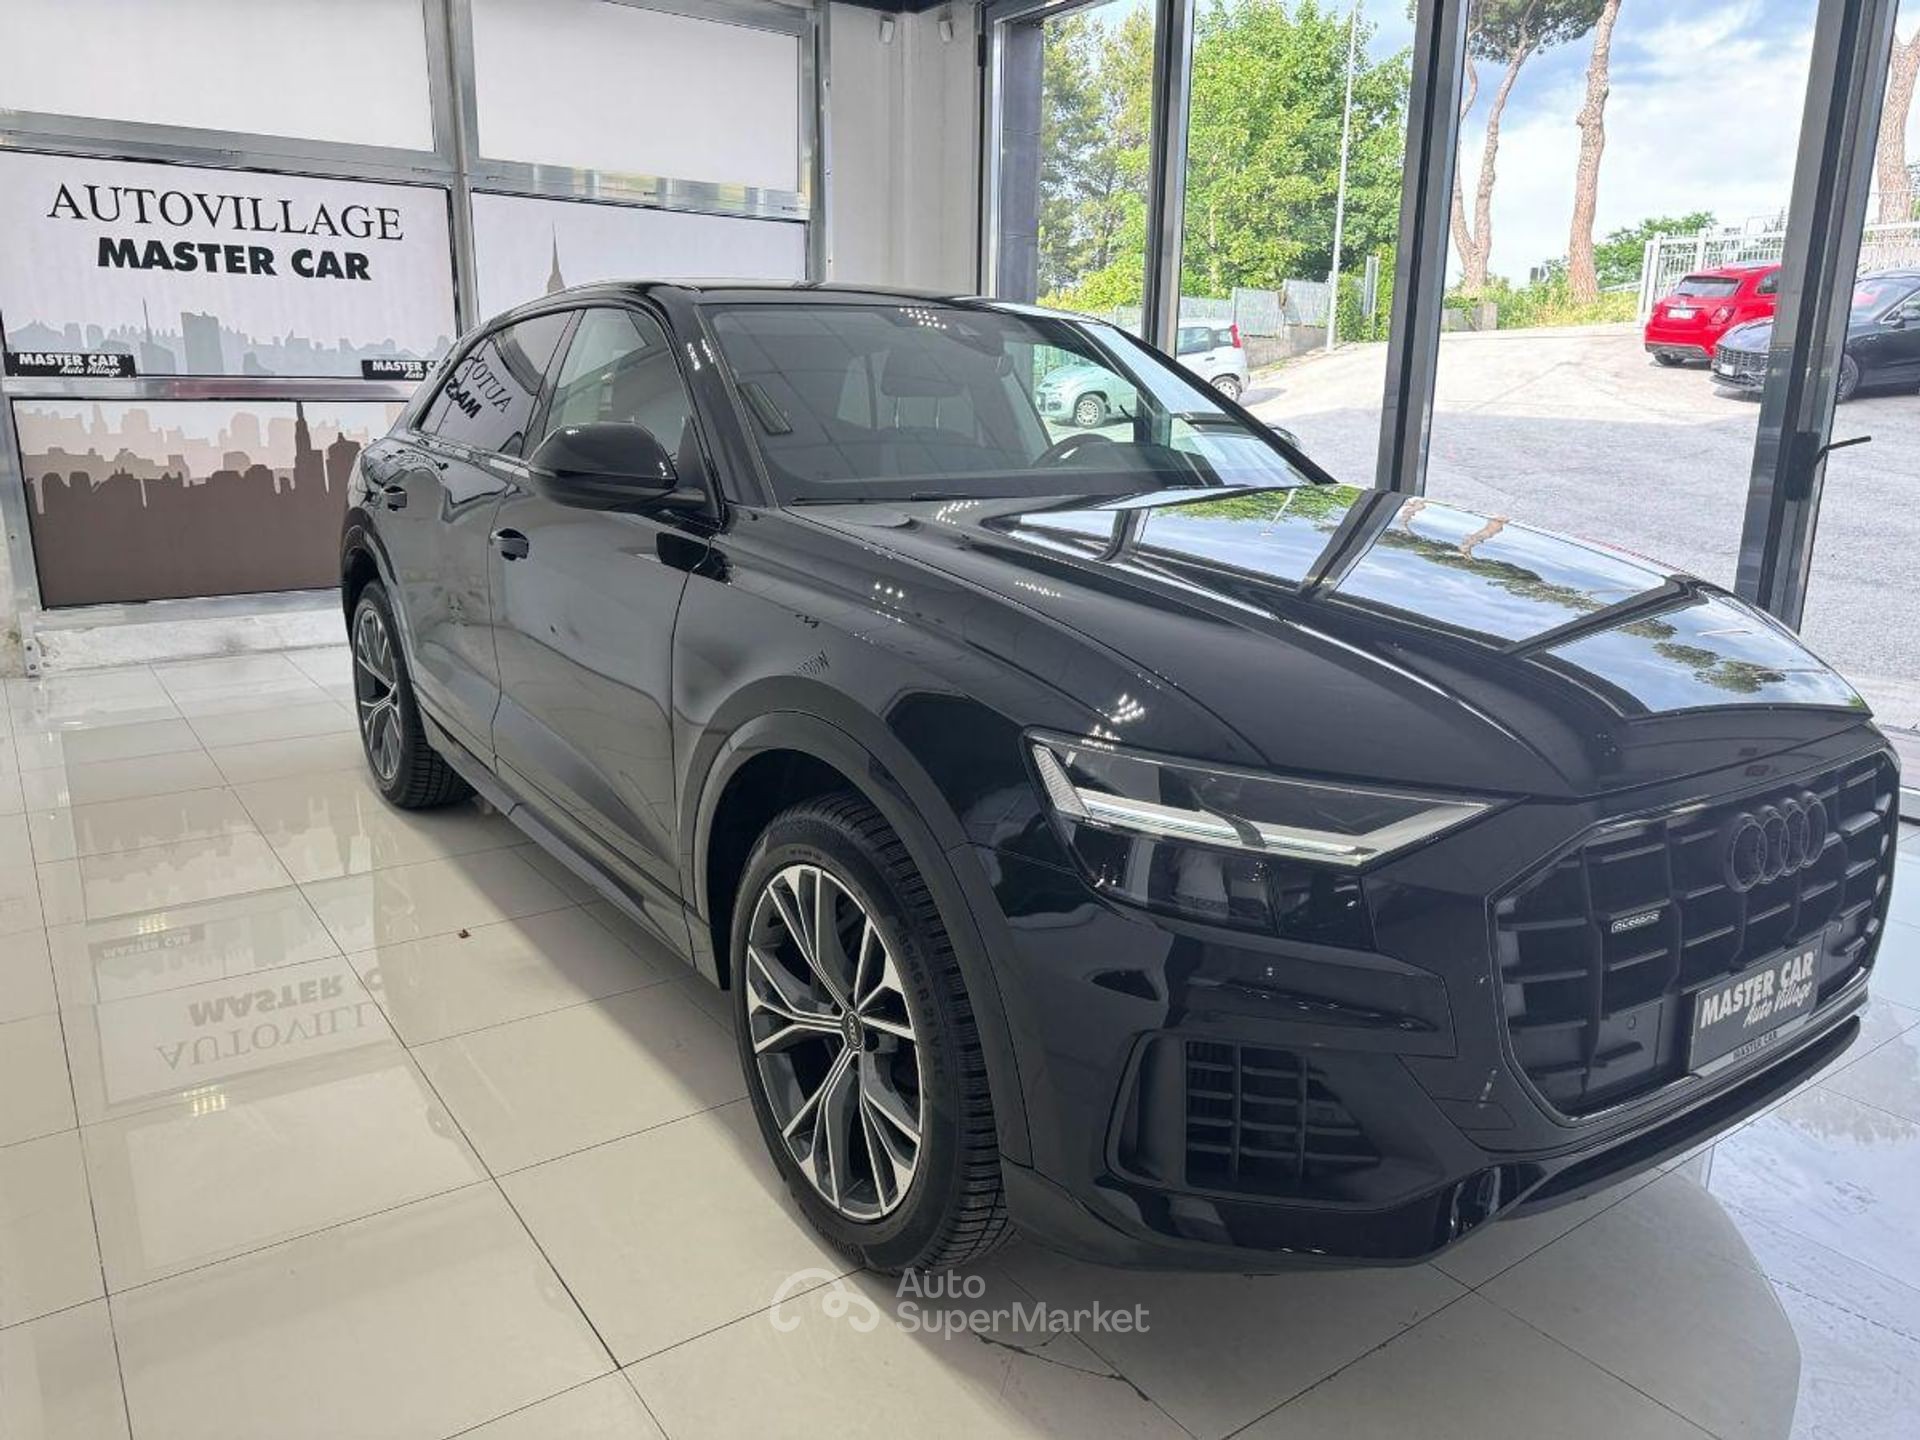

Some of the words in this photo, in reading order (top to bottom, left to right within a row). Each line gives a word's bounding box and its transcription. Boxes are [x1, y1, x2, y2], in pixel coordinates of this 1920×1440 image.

[46, 182, 404, 241] AUTOVILLAGE
[97, 237, 277, 276] MASTER
[291, 248, 372, 281] CAR
[19, 353, 84, 367] MASTER
[87, 354, 120, 367] CAR
[60, 366, 85, 375] Auto
[87, 365, 121, 377] Village
[372, 361, 423, 372] MASTER
[1700, 969, 1775, 1029] MASTER
[1780, 951, 1815, 988] CAR
[1743, 997, 1773, 1028] Auto
[1773, 981, 1813, 1013] Village
